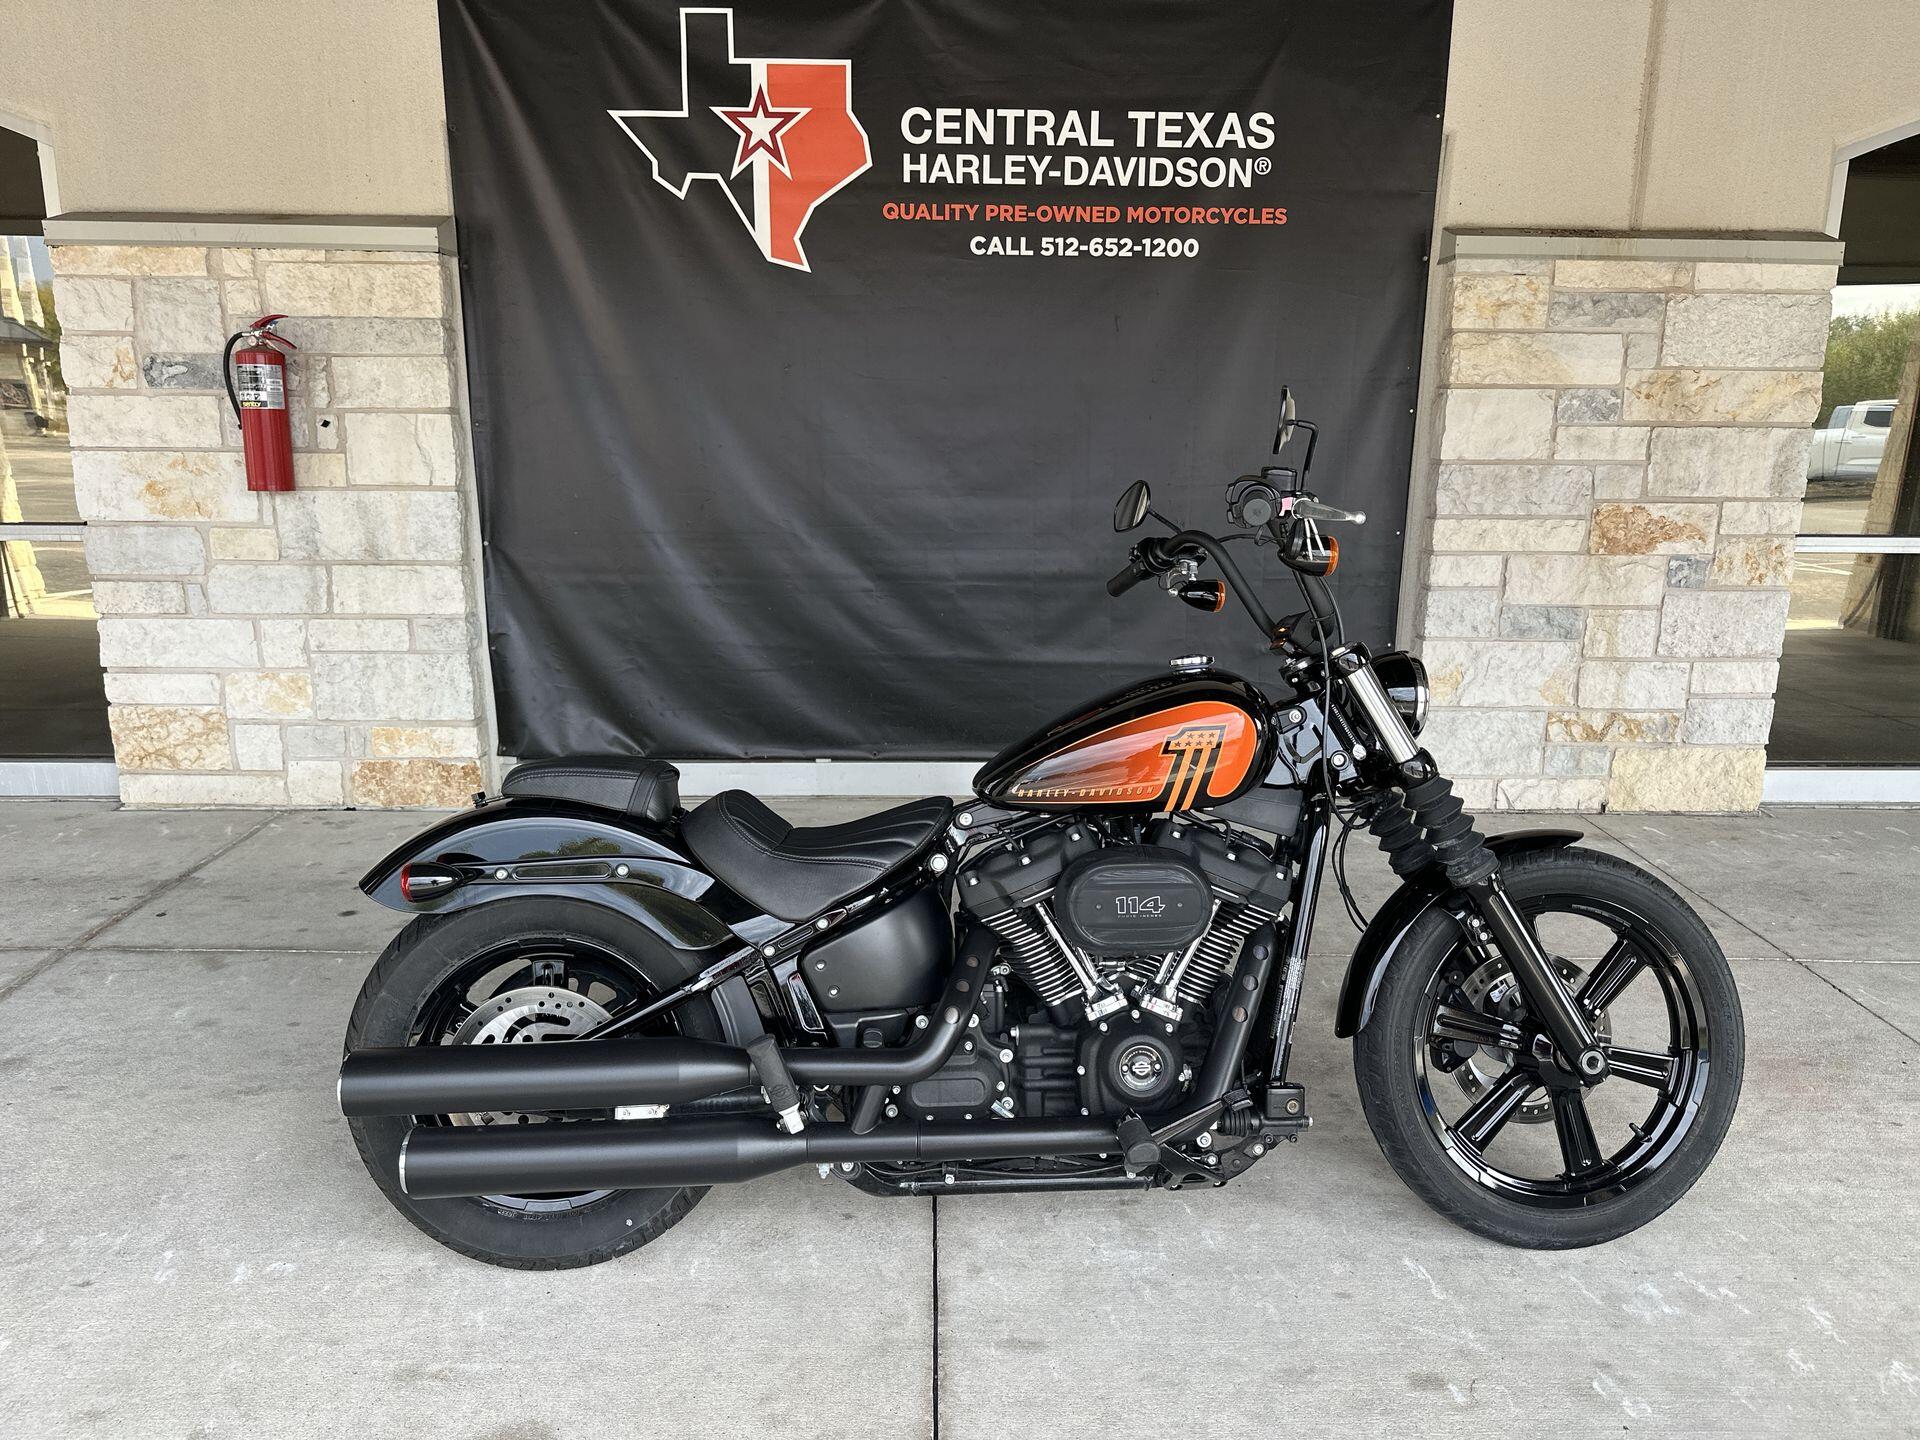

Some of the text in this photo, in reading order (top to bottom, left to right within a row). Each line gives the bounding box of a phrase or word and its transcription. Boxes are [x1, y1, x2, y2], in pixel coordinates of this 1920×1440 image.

[900, 106, 1276, 150] CENTRAL TEXAS
[881, 202, 1289, 226] QUALITY PRE-OWNED MOTORCYCLES
[969, 235, 1200, 259] CALL 512-652-1200
[1115, 896, 1166, 913] 114
